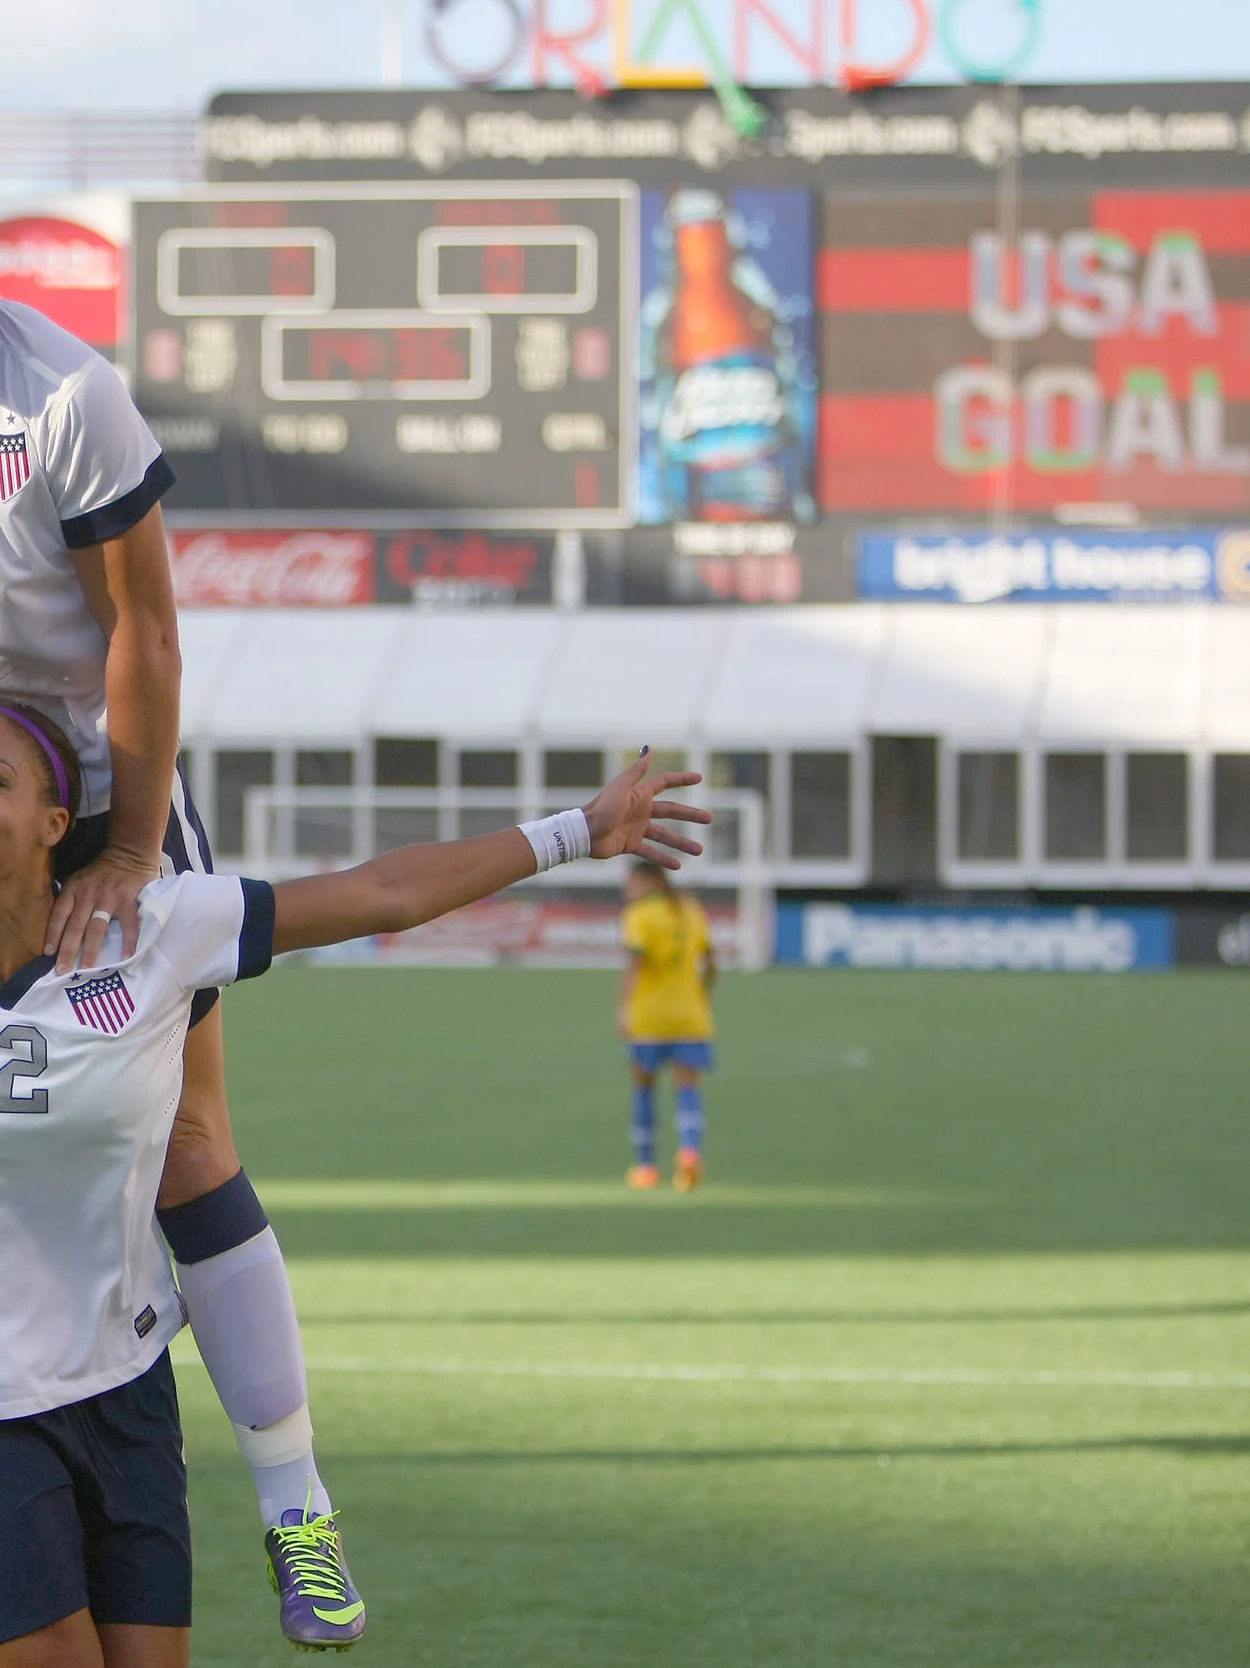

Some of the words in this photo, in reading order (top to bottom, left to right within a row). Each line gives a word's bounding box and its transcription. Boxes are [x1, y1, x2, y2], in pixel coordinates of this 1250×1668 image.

[423, 0, 1038, 134] ORLANDO
[969, 228, 1220, 341] USA
[934, 360, 1250, 476] GOAL
[894, 537, 1050, 602] bright
[1054, 537, 1213, 590] house
[803, 902, 1136, 970] Panasonic
